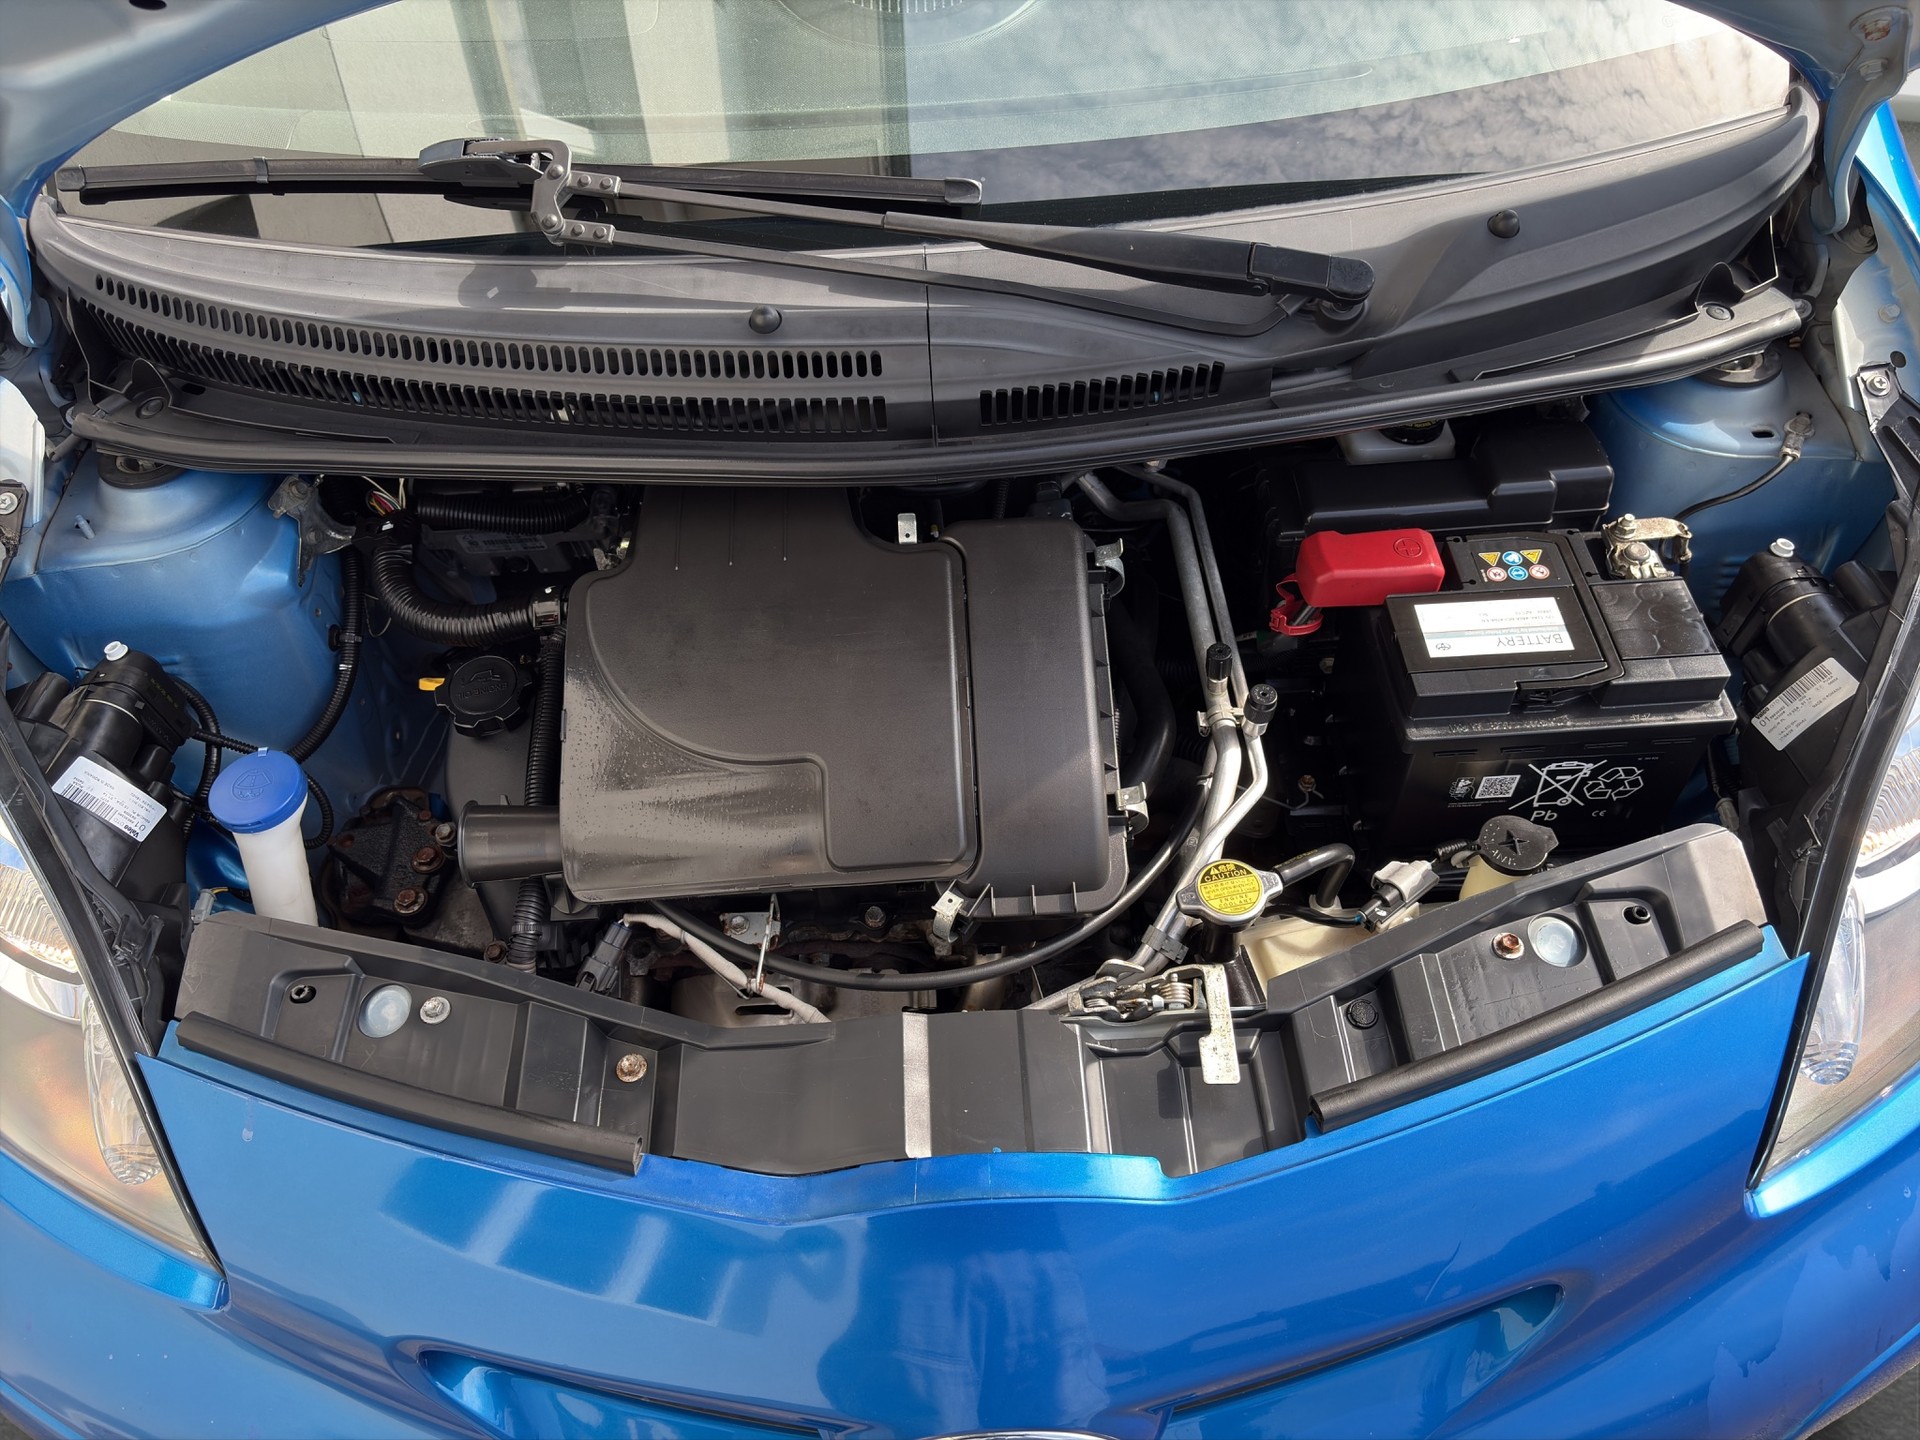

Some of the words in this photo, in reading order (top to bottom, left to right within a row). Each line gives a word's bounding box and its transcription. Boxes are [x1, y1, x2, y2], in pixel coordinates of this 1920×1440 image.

[1497, 633, 1564, 647] BATTERY
[456, 690, 472, 701] OIL
[473, 682, 508, 697] ENGINE
[1754, 706, 1770, 719] Valeo
[1759, 715, 1771, 727] 01
[1530, 810, 1558, 821] Pb
[122, 823, 139, 838] Valeo
[133, 820, 146, 832] 01
[1204, 869, 1247, 882] CAUTION
[1218, 898, 1252, 907] COOLANT
[1219, 894, 1247, 902] ENGINE
